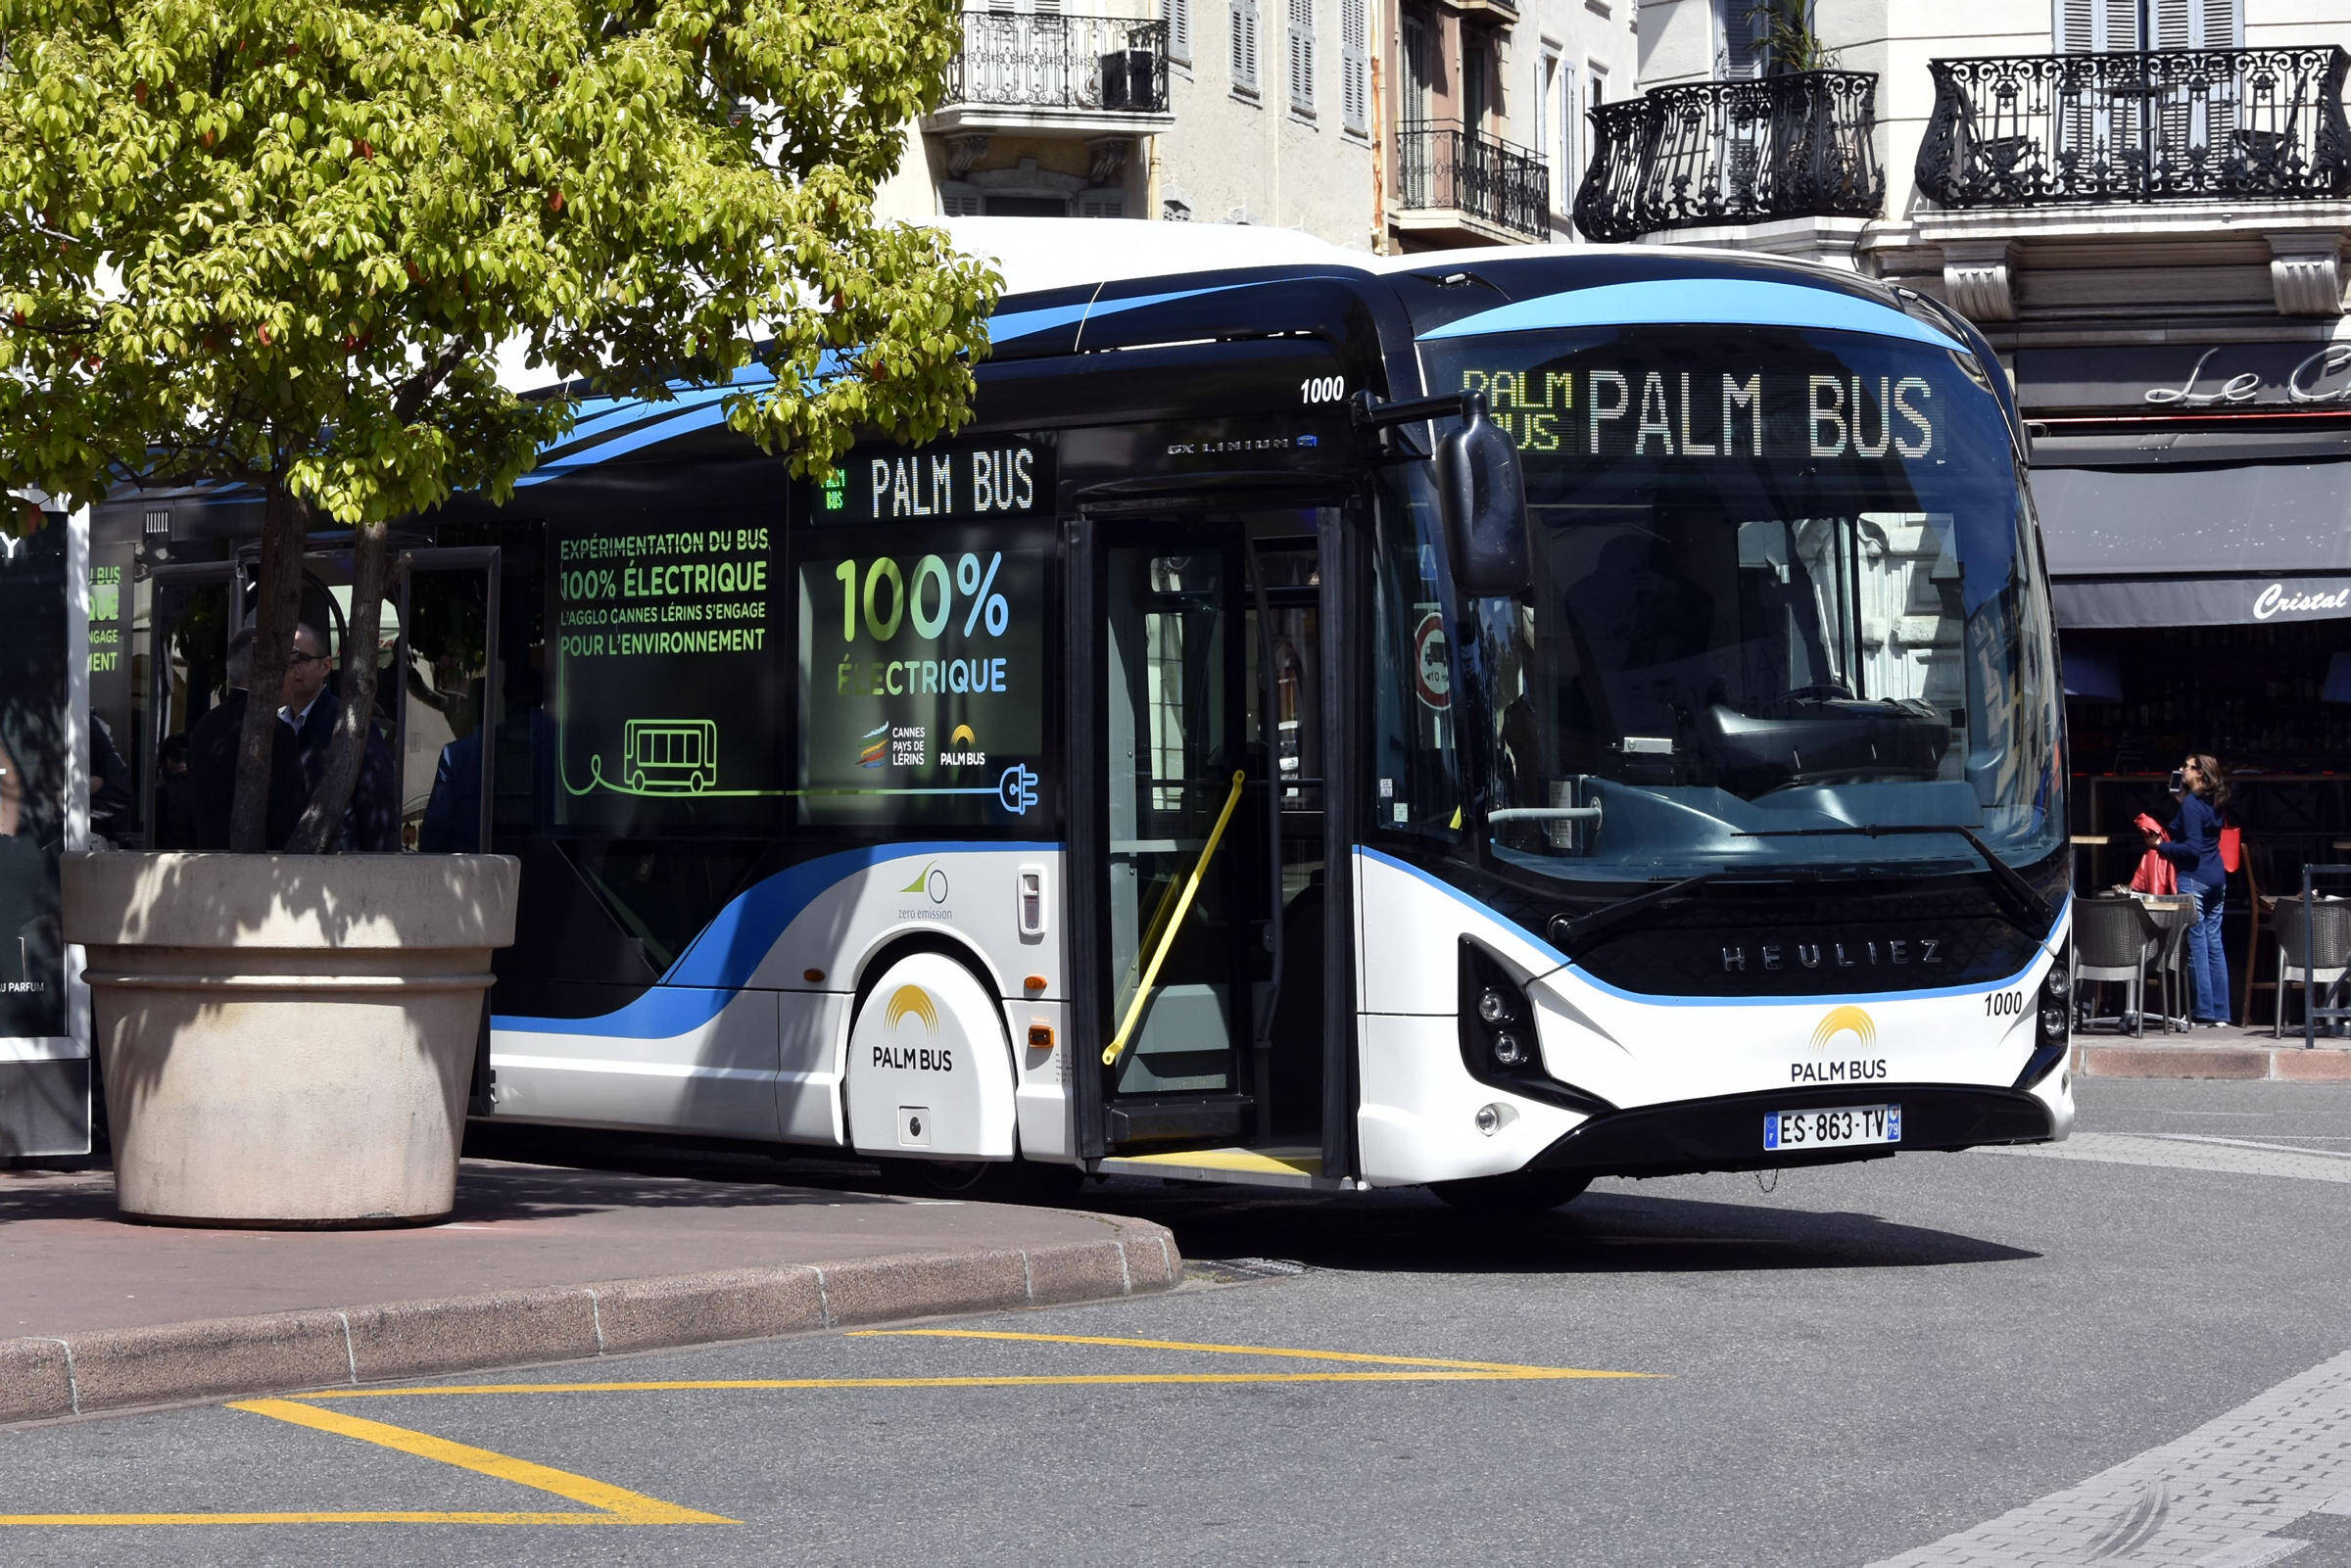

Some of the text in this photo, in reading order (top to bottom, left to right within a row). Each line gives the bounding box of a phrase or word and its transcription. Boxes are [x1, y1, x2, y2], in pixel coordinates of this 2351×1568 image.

[2144, 346, 2259, 403] Le
[1301, 376, 1344, 404] 1000
[1589, 370, 1932, 457] PALM BUS
[1202, 438, 1289, 452] LINIUM
[1489, 413, 1559, 450] US
[872, 448, 1033, 518] PALM BUS
[826, 491, 843, 509] BUS
[560, 528, 768, 561] EXPÉRIMENTATION DU BUS
[97, 566, 121, 585] BUS
[559, 559, 767, 600] 100% ÉLECTRIQUE
[836, 550, 1009, 642] 100%
[2253, 583, 2351, 620] Cristal
[560, 601, 766, 627] L'AGGLO CANNES LÉRINS S'ENGAGE
[560, 628, 766, 657] POUR L'ENVIRONNEMENT
[838, 653, 1007, 696] ÉLECTRIQUE
[892, 727, 926, 738] CANNES
[892, 740, 925, 752] PAYS DE
[892, 748, 925, 766] LÉRINS
[940, 751, 985, 766] PALM BUS
[898, 907, 953, 921] zero emission
[1722, 939, 1943, 973] HEULIEZ
[8, 981, 45, 993] PARFUM
[1985, 990, 2024, 1018] 1000
[873, 1046, 953, 1072] PALM BUS
[1791, 1059, 1888, 1082] PALM BUS
[1768, 1109, 1898, 1144] F ES-863-TV 79
